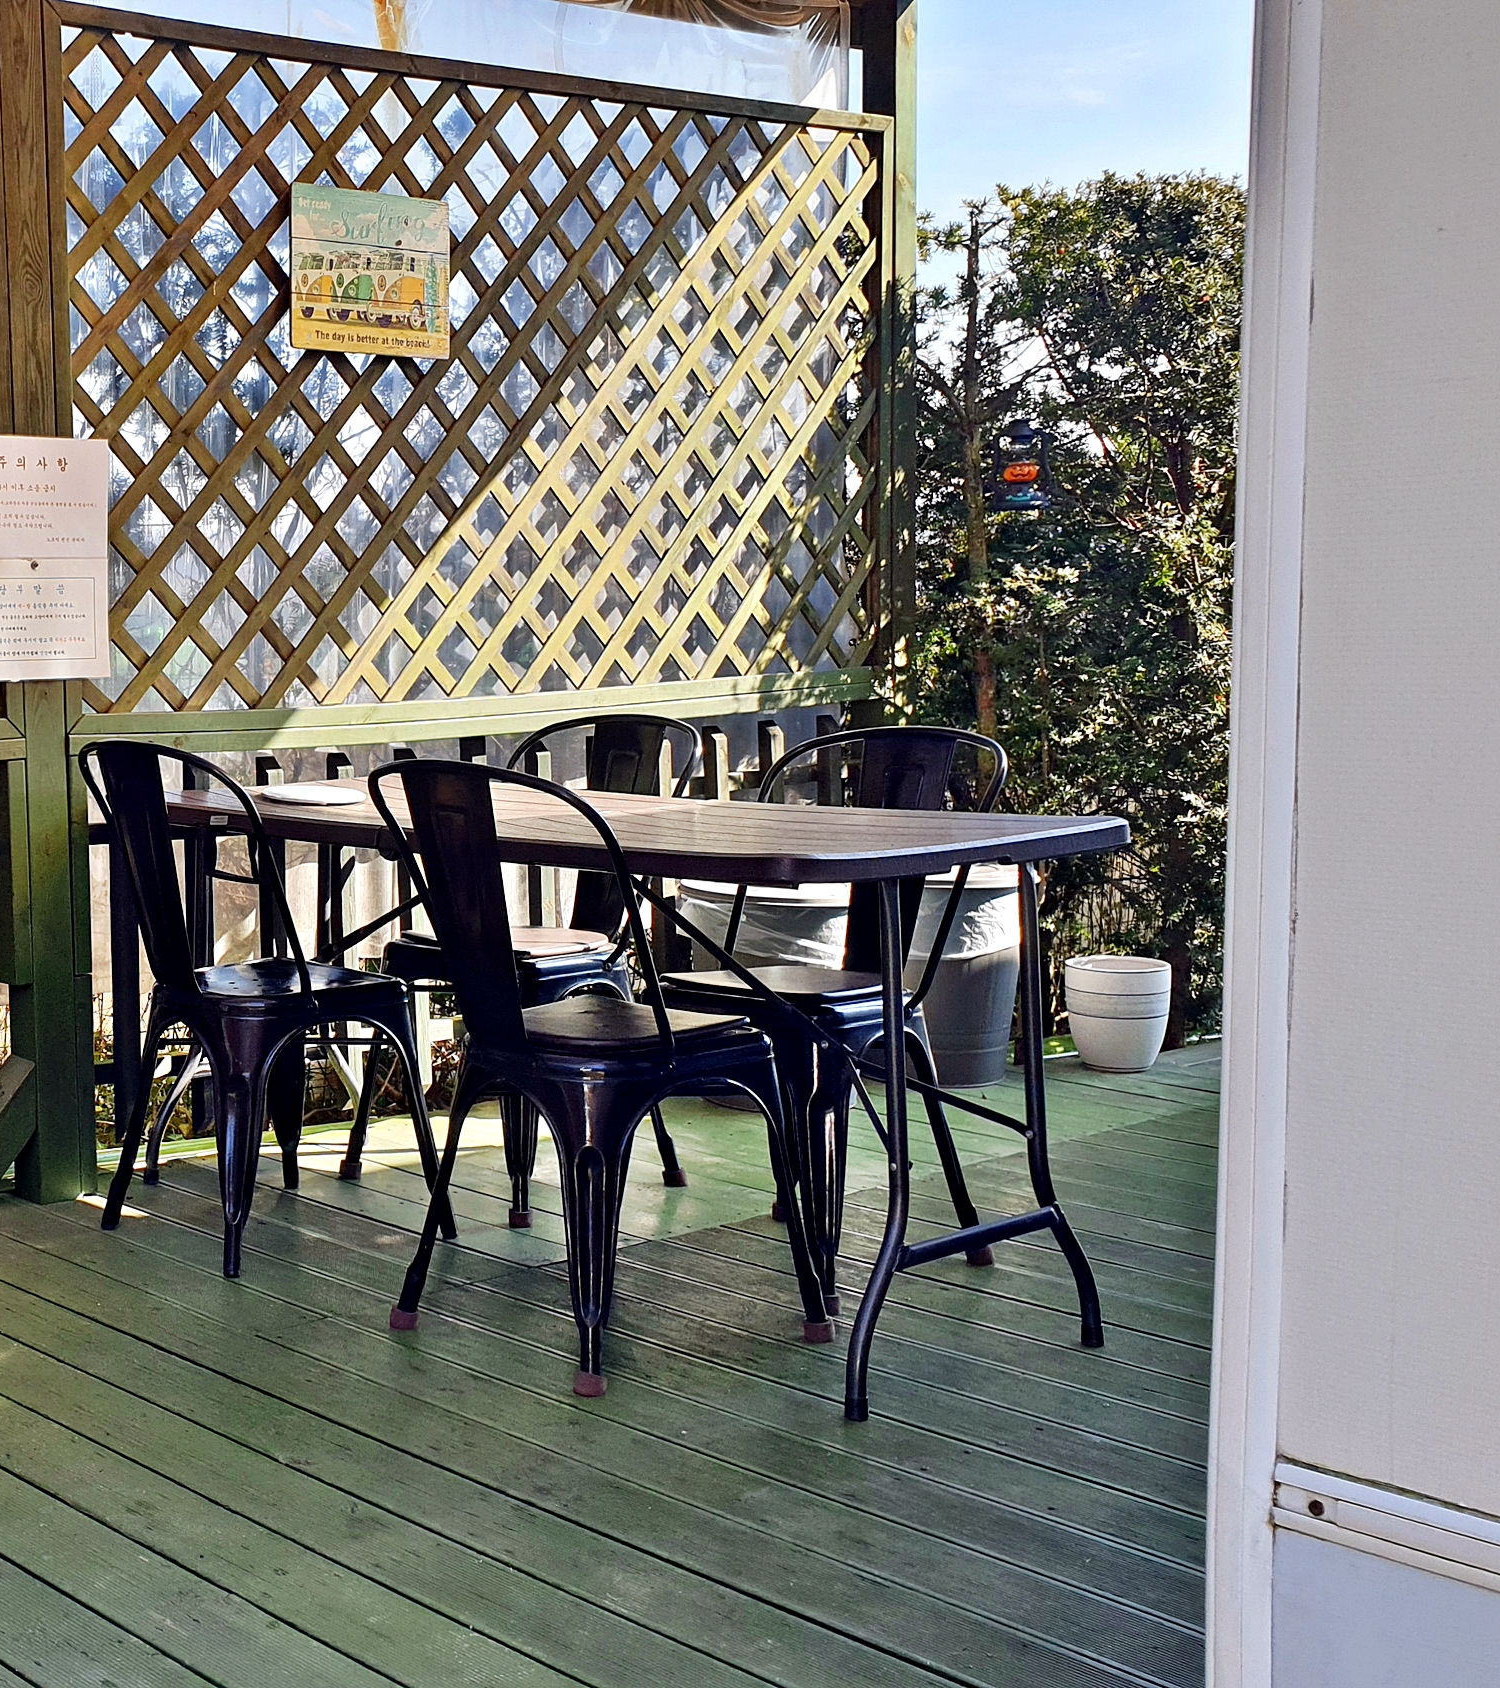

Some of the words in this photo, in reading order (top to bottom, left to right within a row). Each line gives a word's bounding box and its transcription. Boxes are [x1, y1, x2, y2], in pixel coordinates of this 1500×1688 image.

[331, 202, 426, 244] Surfing
[315, 329, 330, 340] The
[331, 332, 346, 343] day
[347, 333, 354, 342] is
[356, 334, 379, 345] better
[381, 336, 389, 345] at
[391, 337, 405, 347] the
